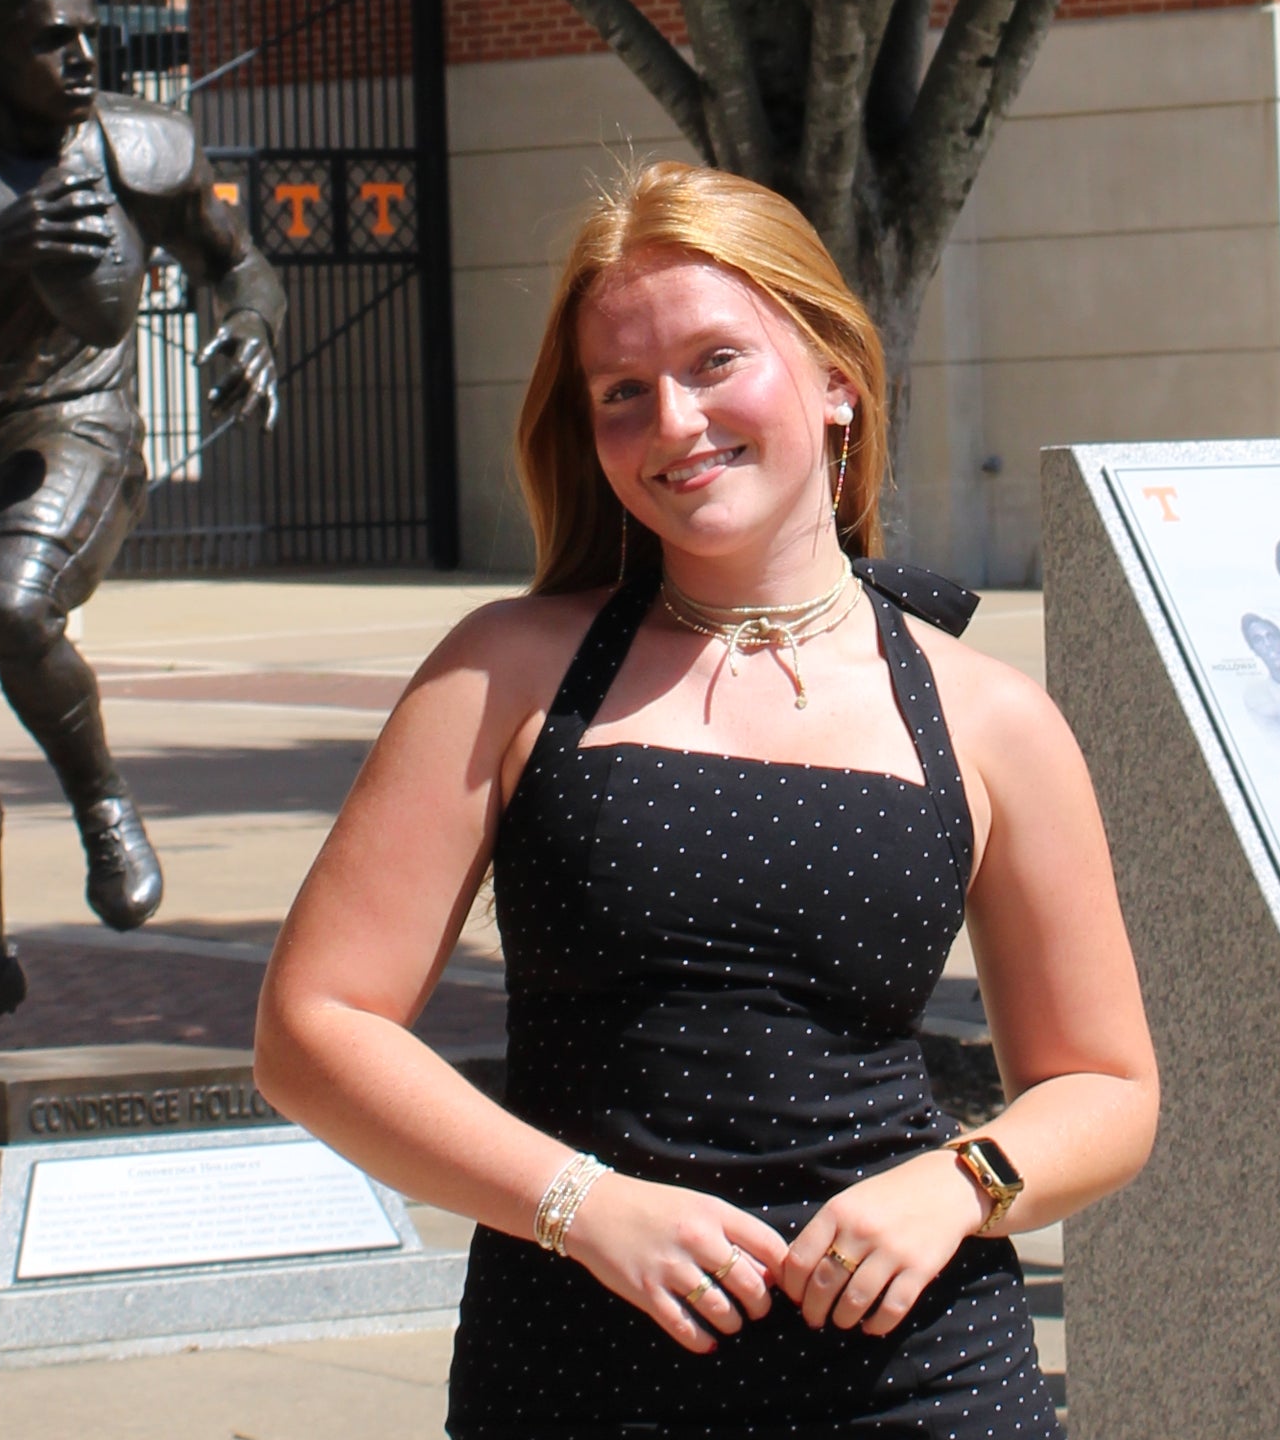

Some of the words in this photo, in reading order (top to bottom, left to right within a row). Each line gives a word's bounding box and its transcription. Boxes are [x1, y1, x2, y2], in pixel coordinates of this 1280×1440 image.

[275, 184, 320, 238] T
[360, 183, 405, 236] T
[1142, 486, 1182, 522] T
[28, 1087, 180, 1134] CONDREDGE
[188, 1083, 277, 1123] HOLLO
